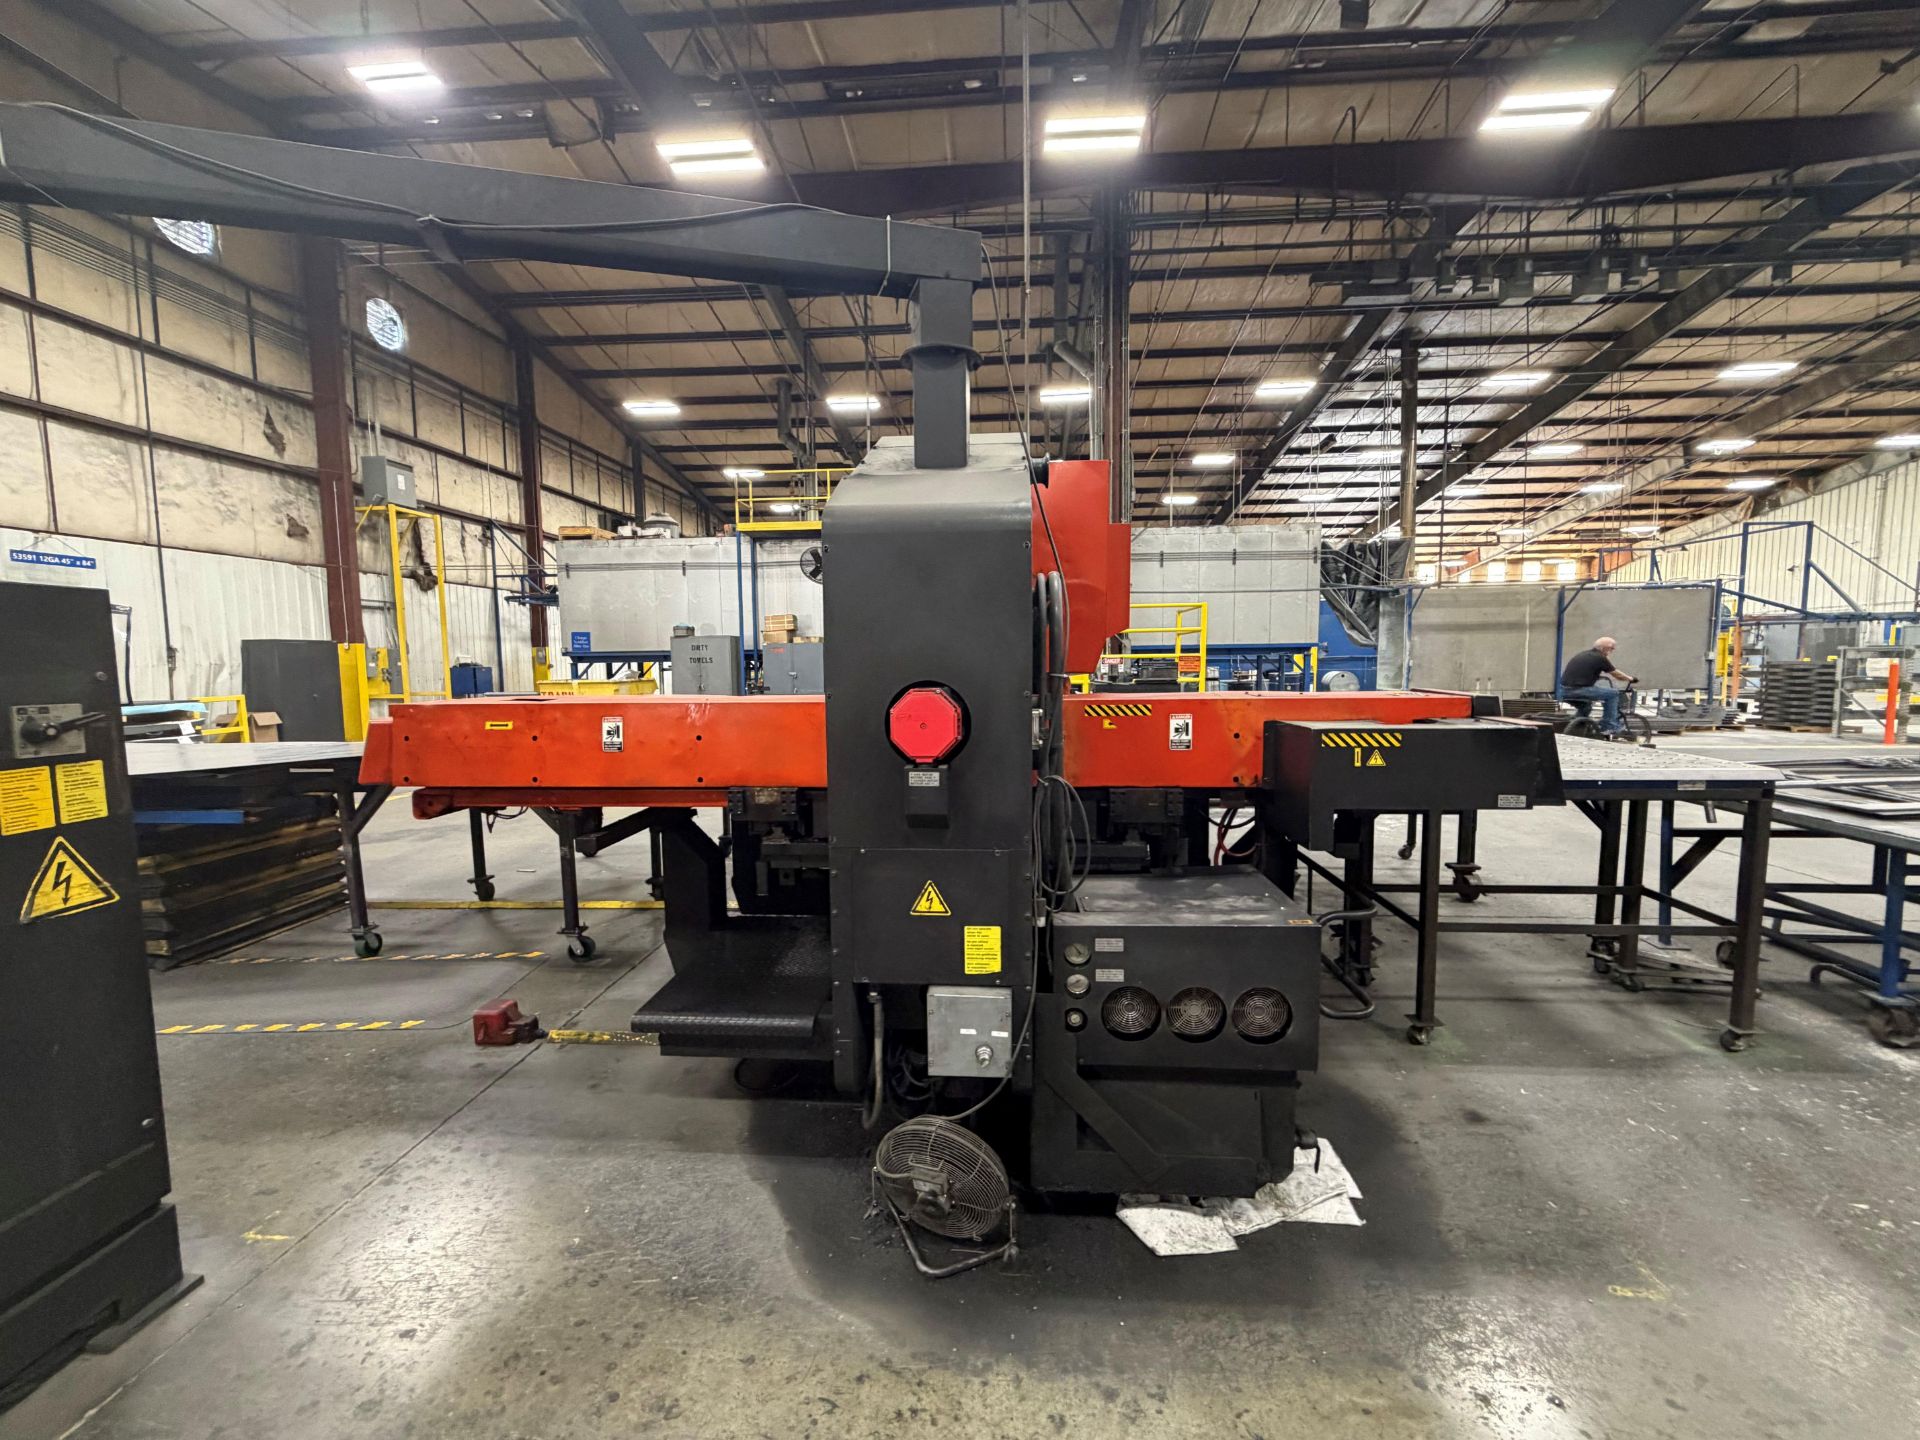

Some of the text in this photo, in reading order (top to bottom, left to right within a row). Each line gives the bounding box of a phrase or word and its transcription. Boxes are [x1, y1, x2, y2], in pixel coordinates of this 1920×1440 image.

[12, 552, 37, 562] 53591
[39, 555, 60, 564] 12GA
[691, 644, 708, 652] DIRTY
